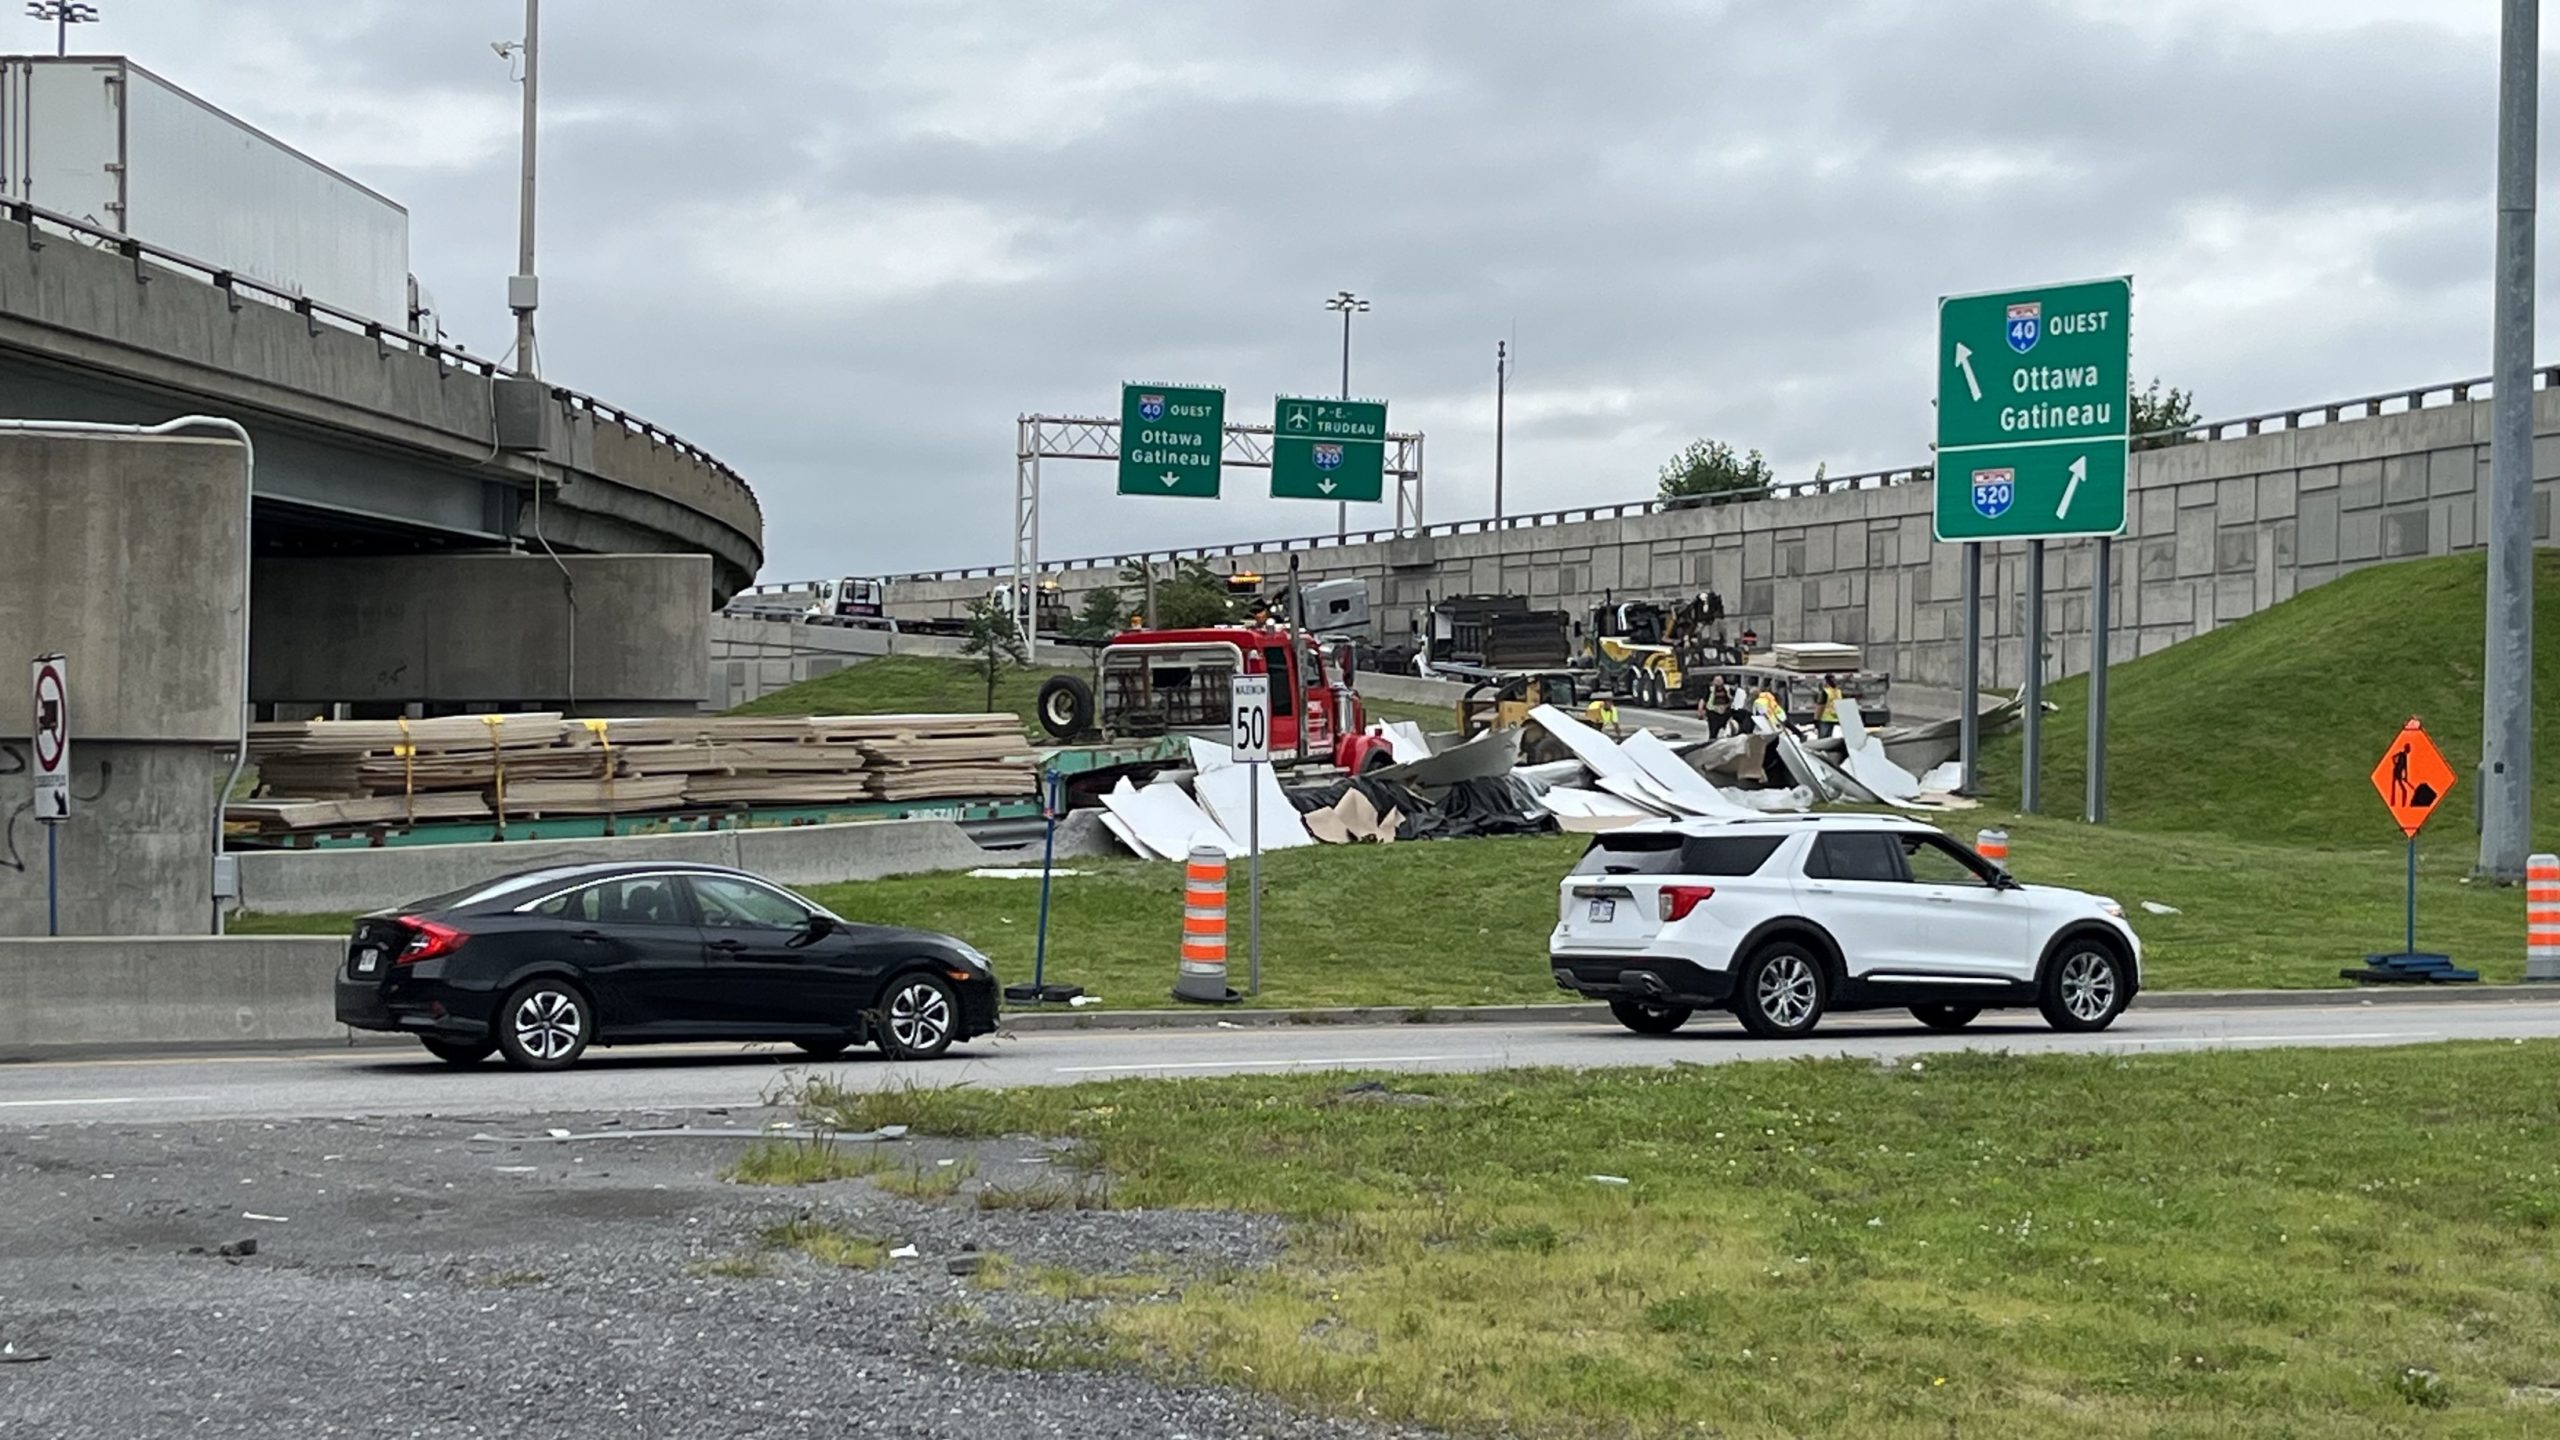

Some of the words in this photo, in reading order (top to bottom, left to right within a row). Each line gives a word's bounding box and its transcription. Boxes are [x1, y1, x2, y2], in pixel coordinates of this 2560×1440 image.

[2011, 321, 2036, 340] 40
[2049, 312, 2109, 336] OUEST
[2012, 365, 2098, 393] Ottawa
[1143, 404, 1161, 416] 40
[1170, 405, 1212, 417] OUEST
[2000, 401, 2110, 431] Gatineau
[1317, 421, 1375, 435] TRUDEAU
[1141, 430, 1202, 446] Ottawa
[1132, 449, 1210, 466] Gatineau
[1316, 453, 1340, 465] 520
[1976, 487, 2010, 505] 520
[1237, 705, 1264, 750] 50
